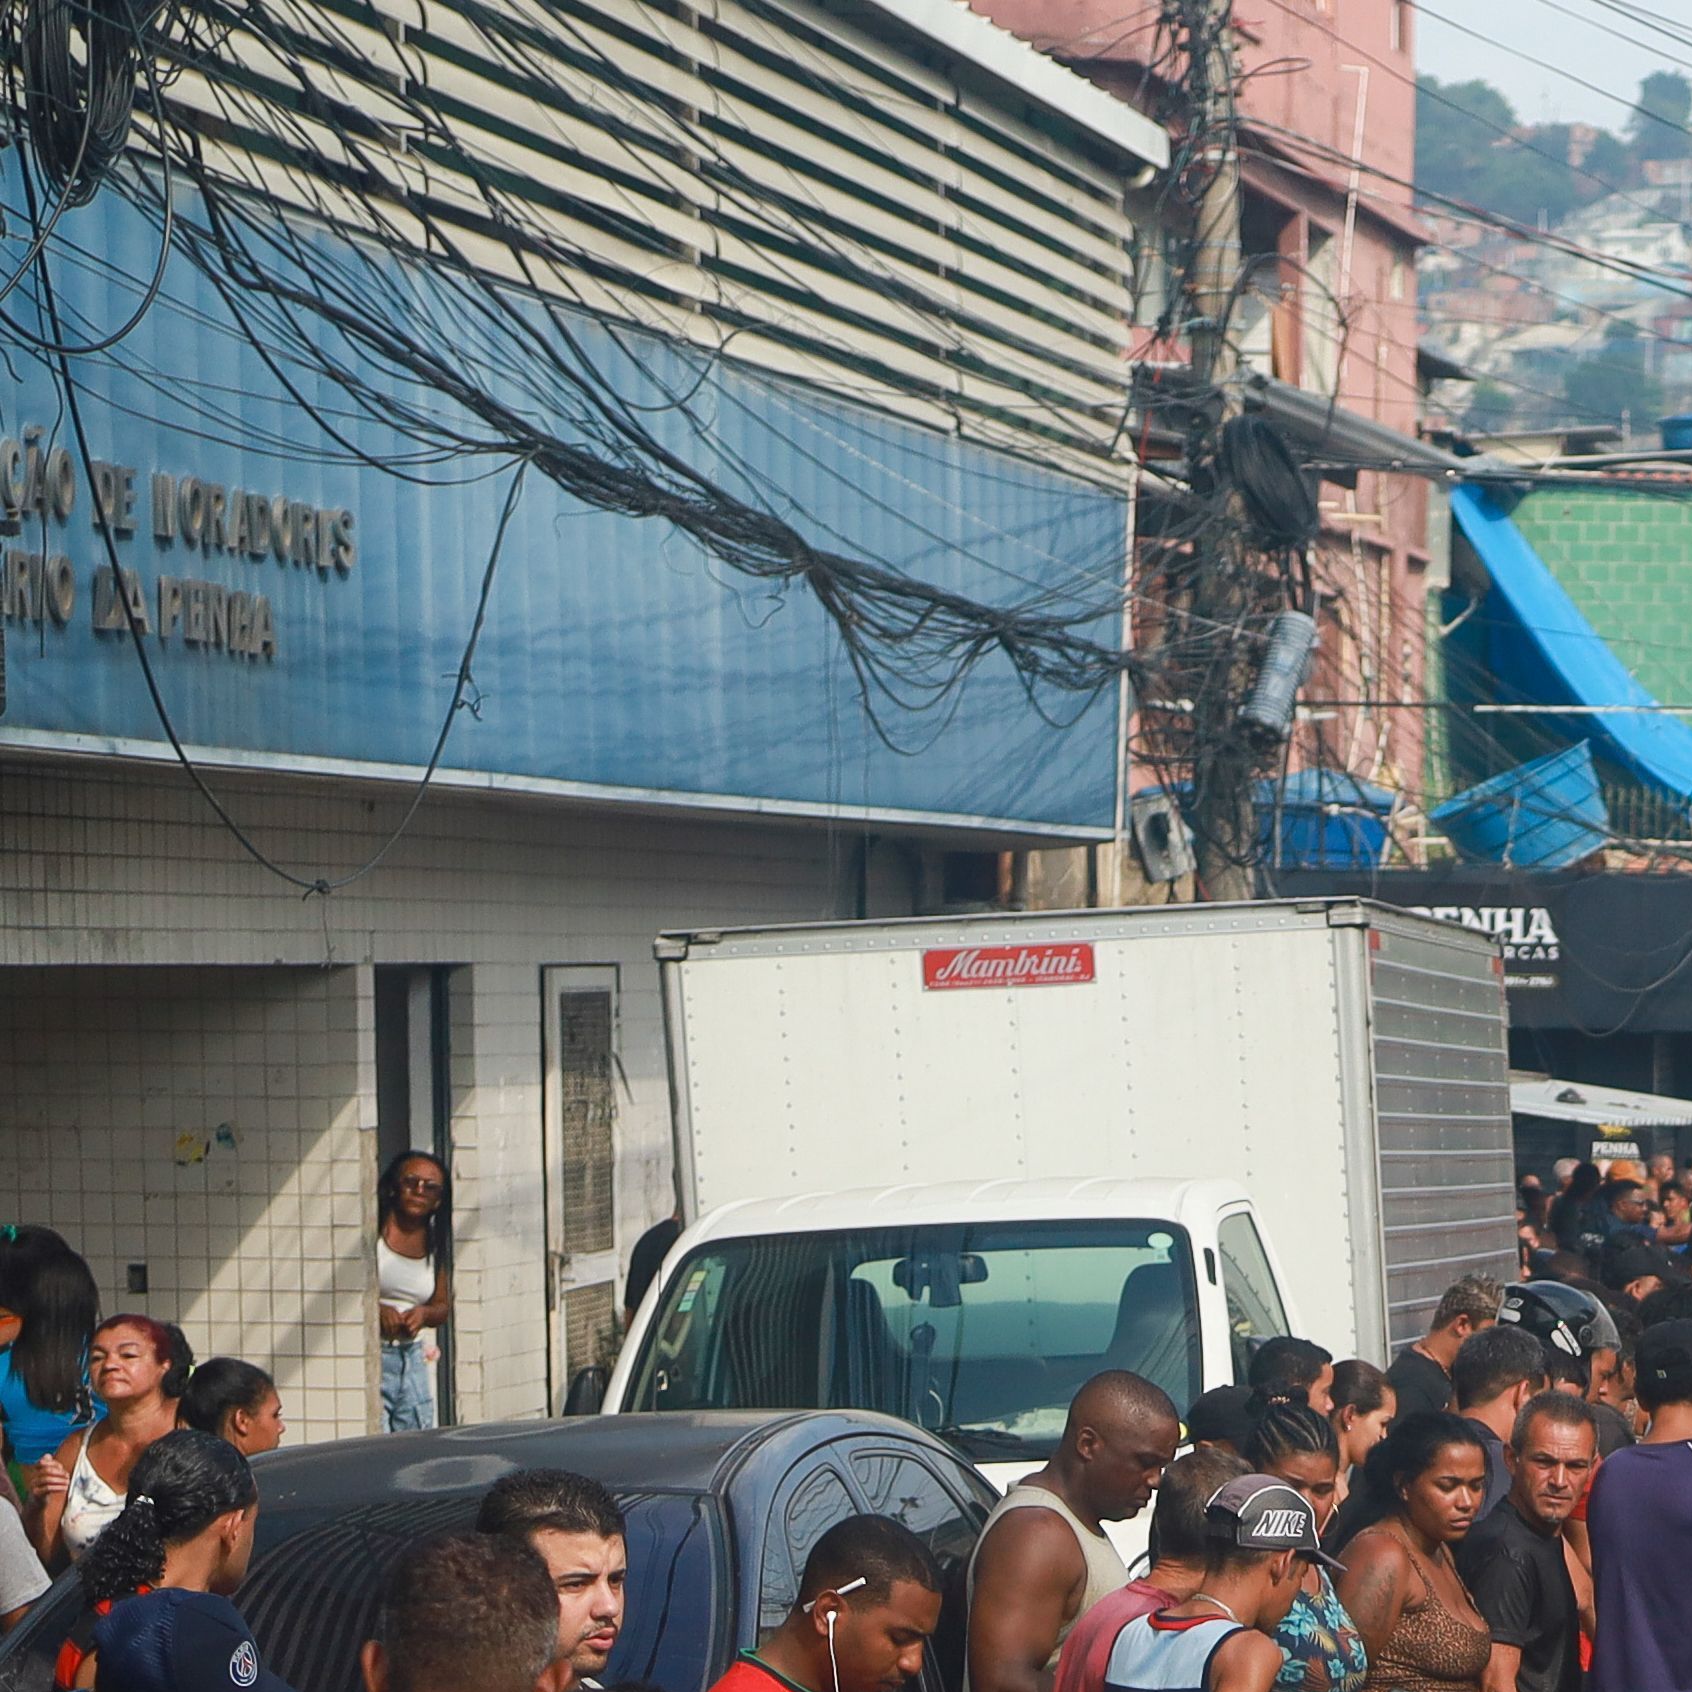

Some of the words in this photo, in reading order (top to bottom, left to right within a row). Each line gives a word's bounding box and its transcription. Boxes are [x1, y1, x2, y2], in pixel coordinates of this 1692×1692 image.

[90, 460, 137, 531] DE
[151, 470, 357, 575] MORADORES
[0, 550, 75, 623] RIO
[92, 564, 149, 631] DA
[157, 574, 276, 655] PENHA
[936, 949, 1081, 980] Mambrini
[1252, 1510, 1306, 1537] NIKE
